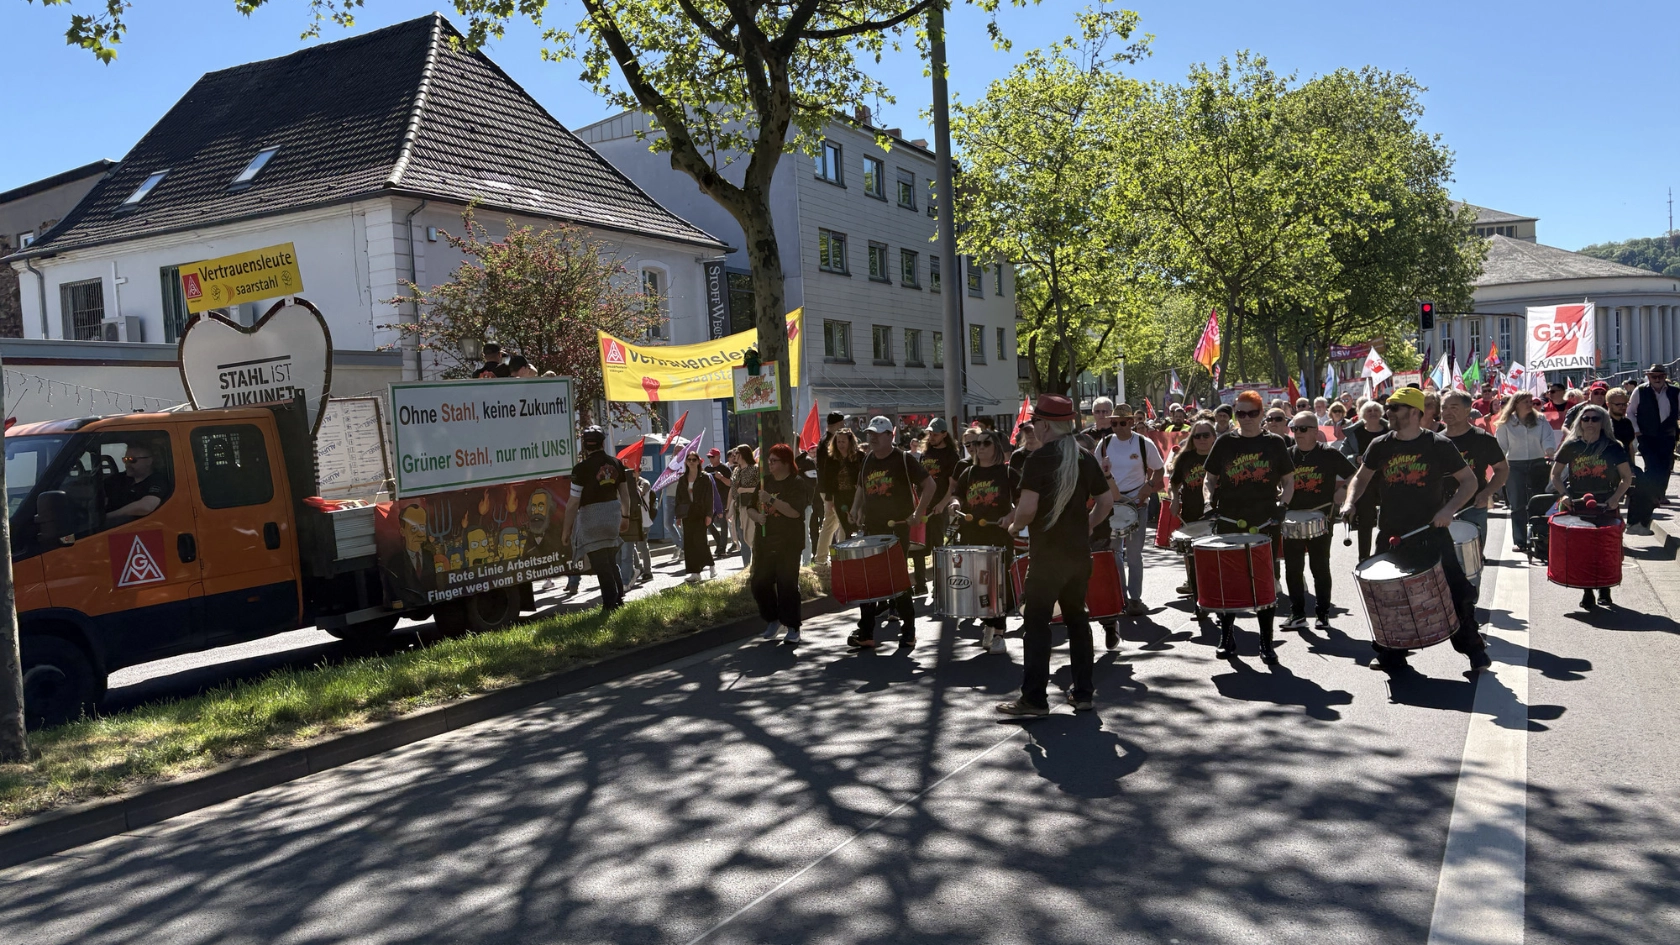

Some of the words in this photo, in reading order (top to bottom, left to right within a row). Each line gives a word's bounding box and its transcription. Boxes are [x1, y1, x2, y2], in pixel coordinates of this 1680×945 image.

[199, 252, 292, 282] Vertrauensleute
[235, 275, 279, 296] saarstahl
[1533, 321, 1588, 342] GEW
[1330, 350, 1350, 358] BSW
[1530, 356, 1594, 370] SAARLAND
[219, 367, 269, 390] STAHL
[270, 363, 292, 383] IST
[684, 370, 733, 385] saarsta
[400, 405, 437, 425] Ohne
[441, 402, 480, 423] Stahl,
[482, 400, 516, 419] keine
[519, 397, 568, 417] Zukunft!
[402, 453, 451, 474] Grüner
[455, 446, 493, 468] Stahl,
[496, 449, 517, 463] nur
[520, 441, 539, 460] mit
[541, 438, 570, 458] UNS!
[1388, 454, 1417, 467] SAMBA
[448, 570, 478, 584] Rote
[477, 565, 504, 578] Linie
[506, 551, 560, 572] Arbeitszeit
[427, 587, 464, 602] Finger
[465, 580, 490, 595] weg
[492, 576, 514, 587] vom
[516, 571, 523, 582] 8
[525, 562, 565, 580] Stunden
[949, 578, 970, 586] IZZO
